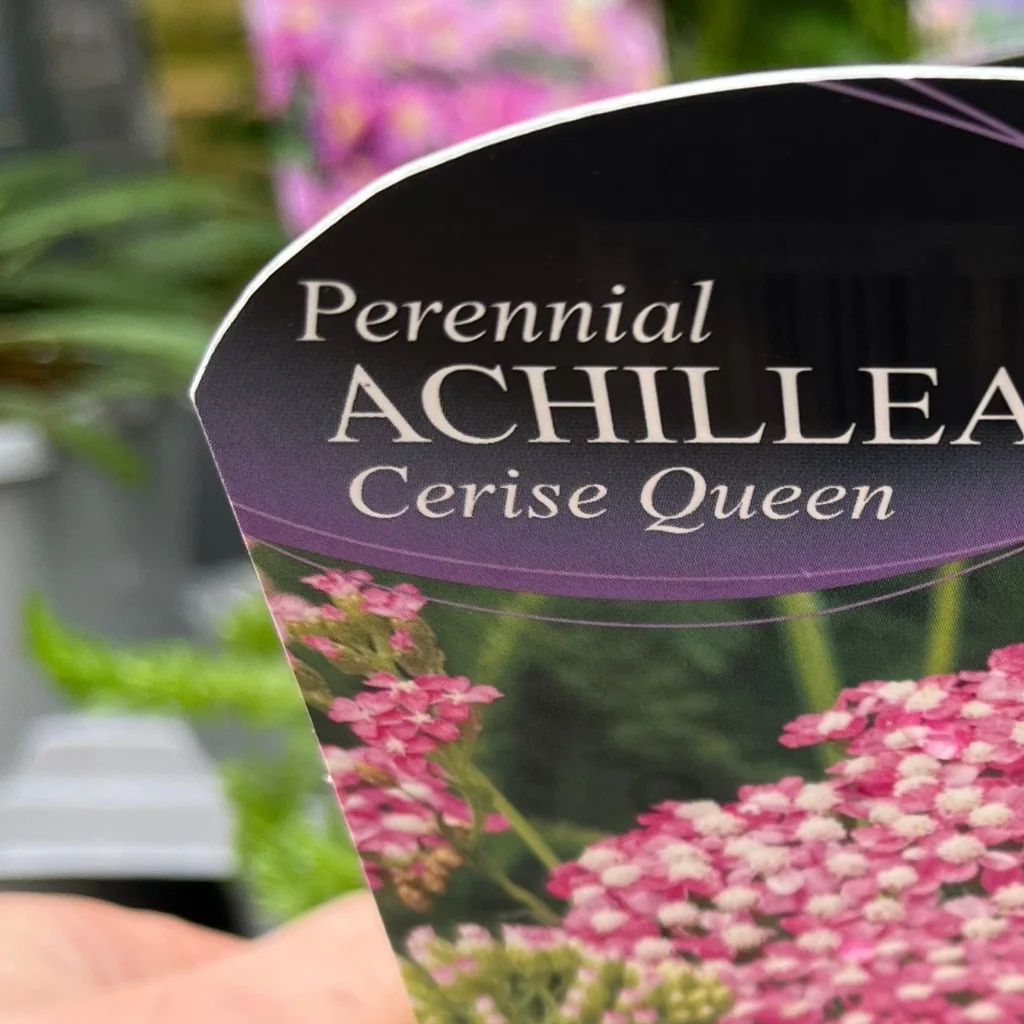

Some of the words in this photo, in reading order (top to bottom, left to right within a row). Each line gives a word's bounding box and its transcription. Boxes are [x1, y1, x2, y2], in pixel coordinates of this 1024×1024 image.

[296, 279, 714, 344] Perennial
[348, 466, 608, 521] Cerise
[640, 466, 895, 535] Queen
